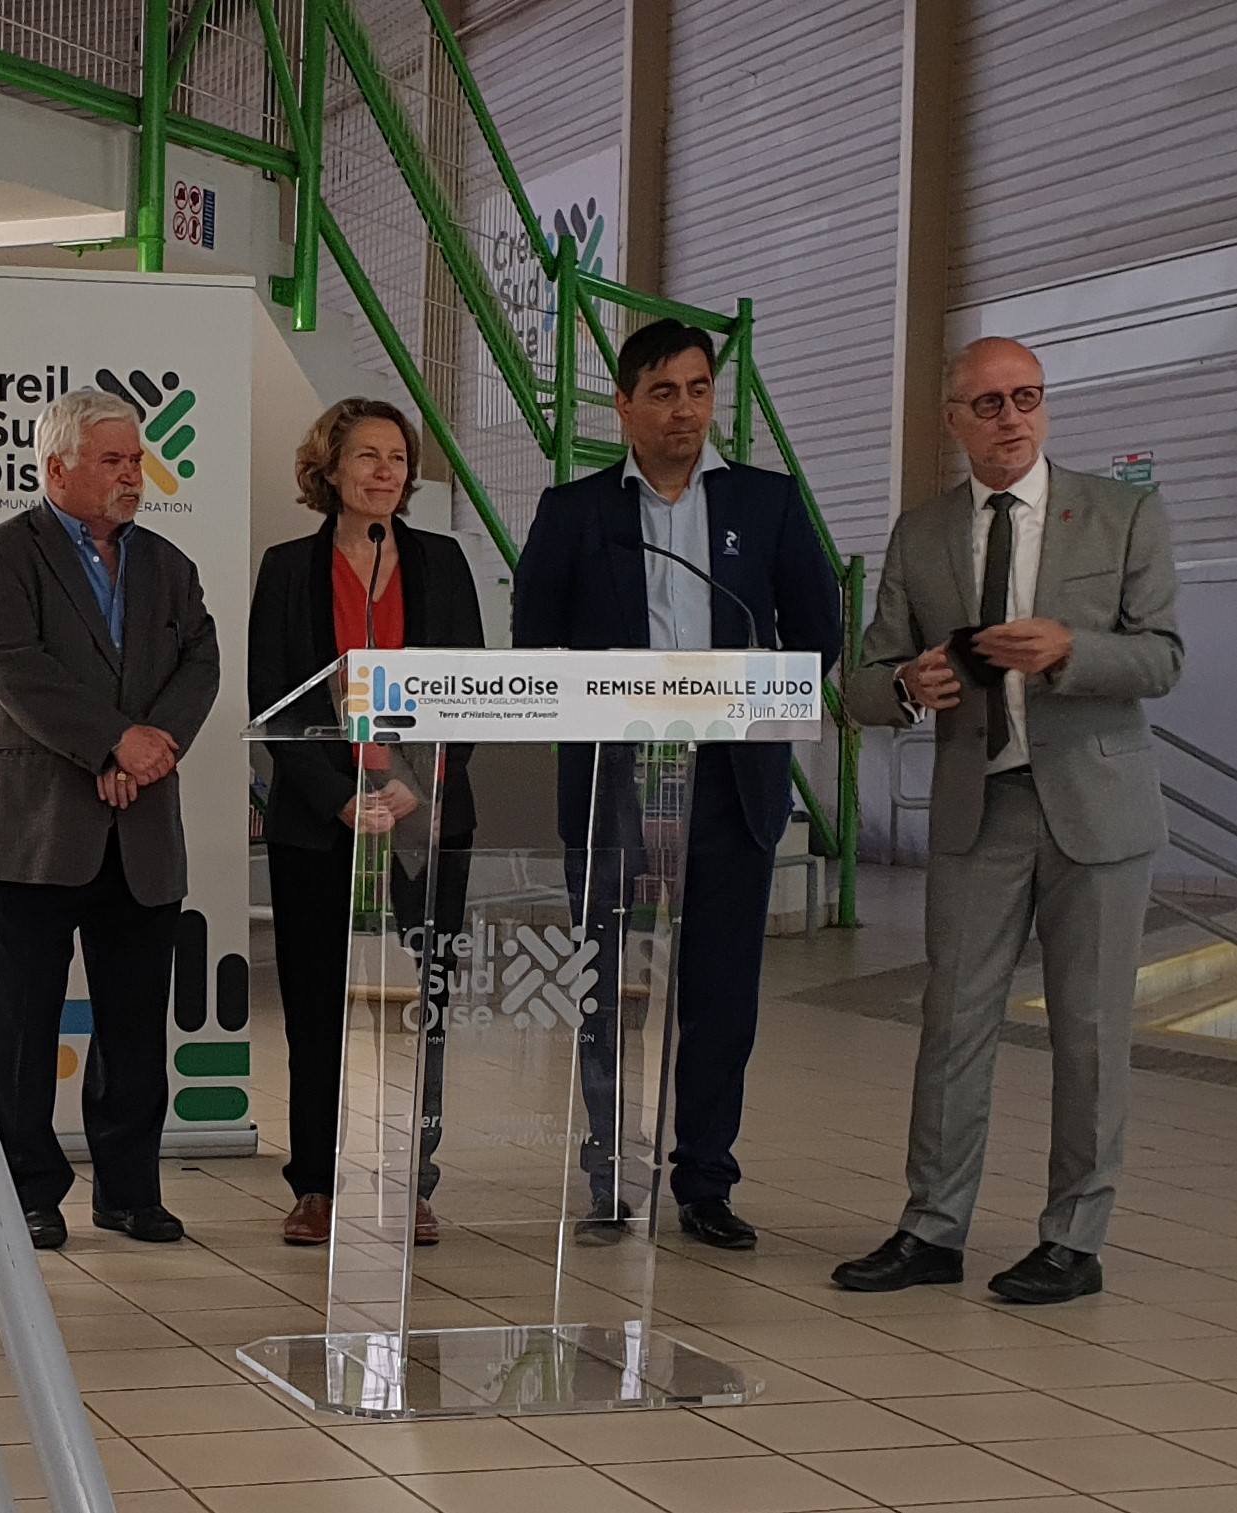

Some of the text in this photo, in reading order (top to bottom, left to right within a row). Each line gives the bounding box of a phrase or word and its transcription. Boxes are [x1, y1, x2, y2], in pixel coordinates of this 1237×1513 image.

[404, 676, 559, 695] Creil Sud Oise
[586, 677, 813, 695] REMISE MÉDAILLE JUDO
[438, 711, 460, 719] Terre
[461, 711, 503, 720] d'Histoire,
[525, 711, 559, 719] d'Avenir
[727, 703, 813, 720] 23 juin 2021
[420, 961, 495, 996] Sud
